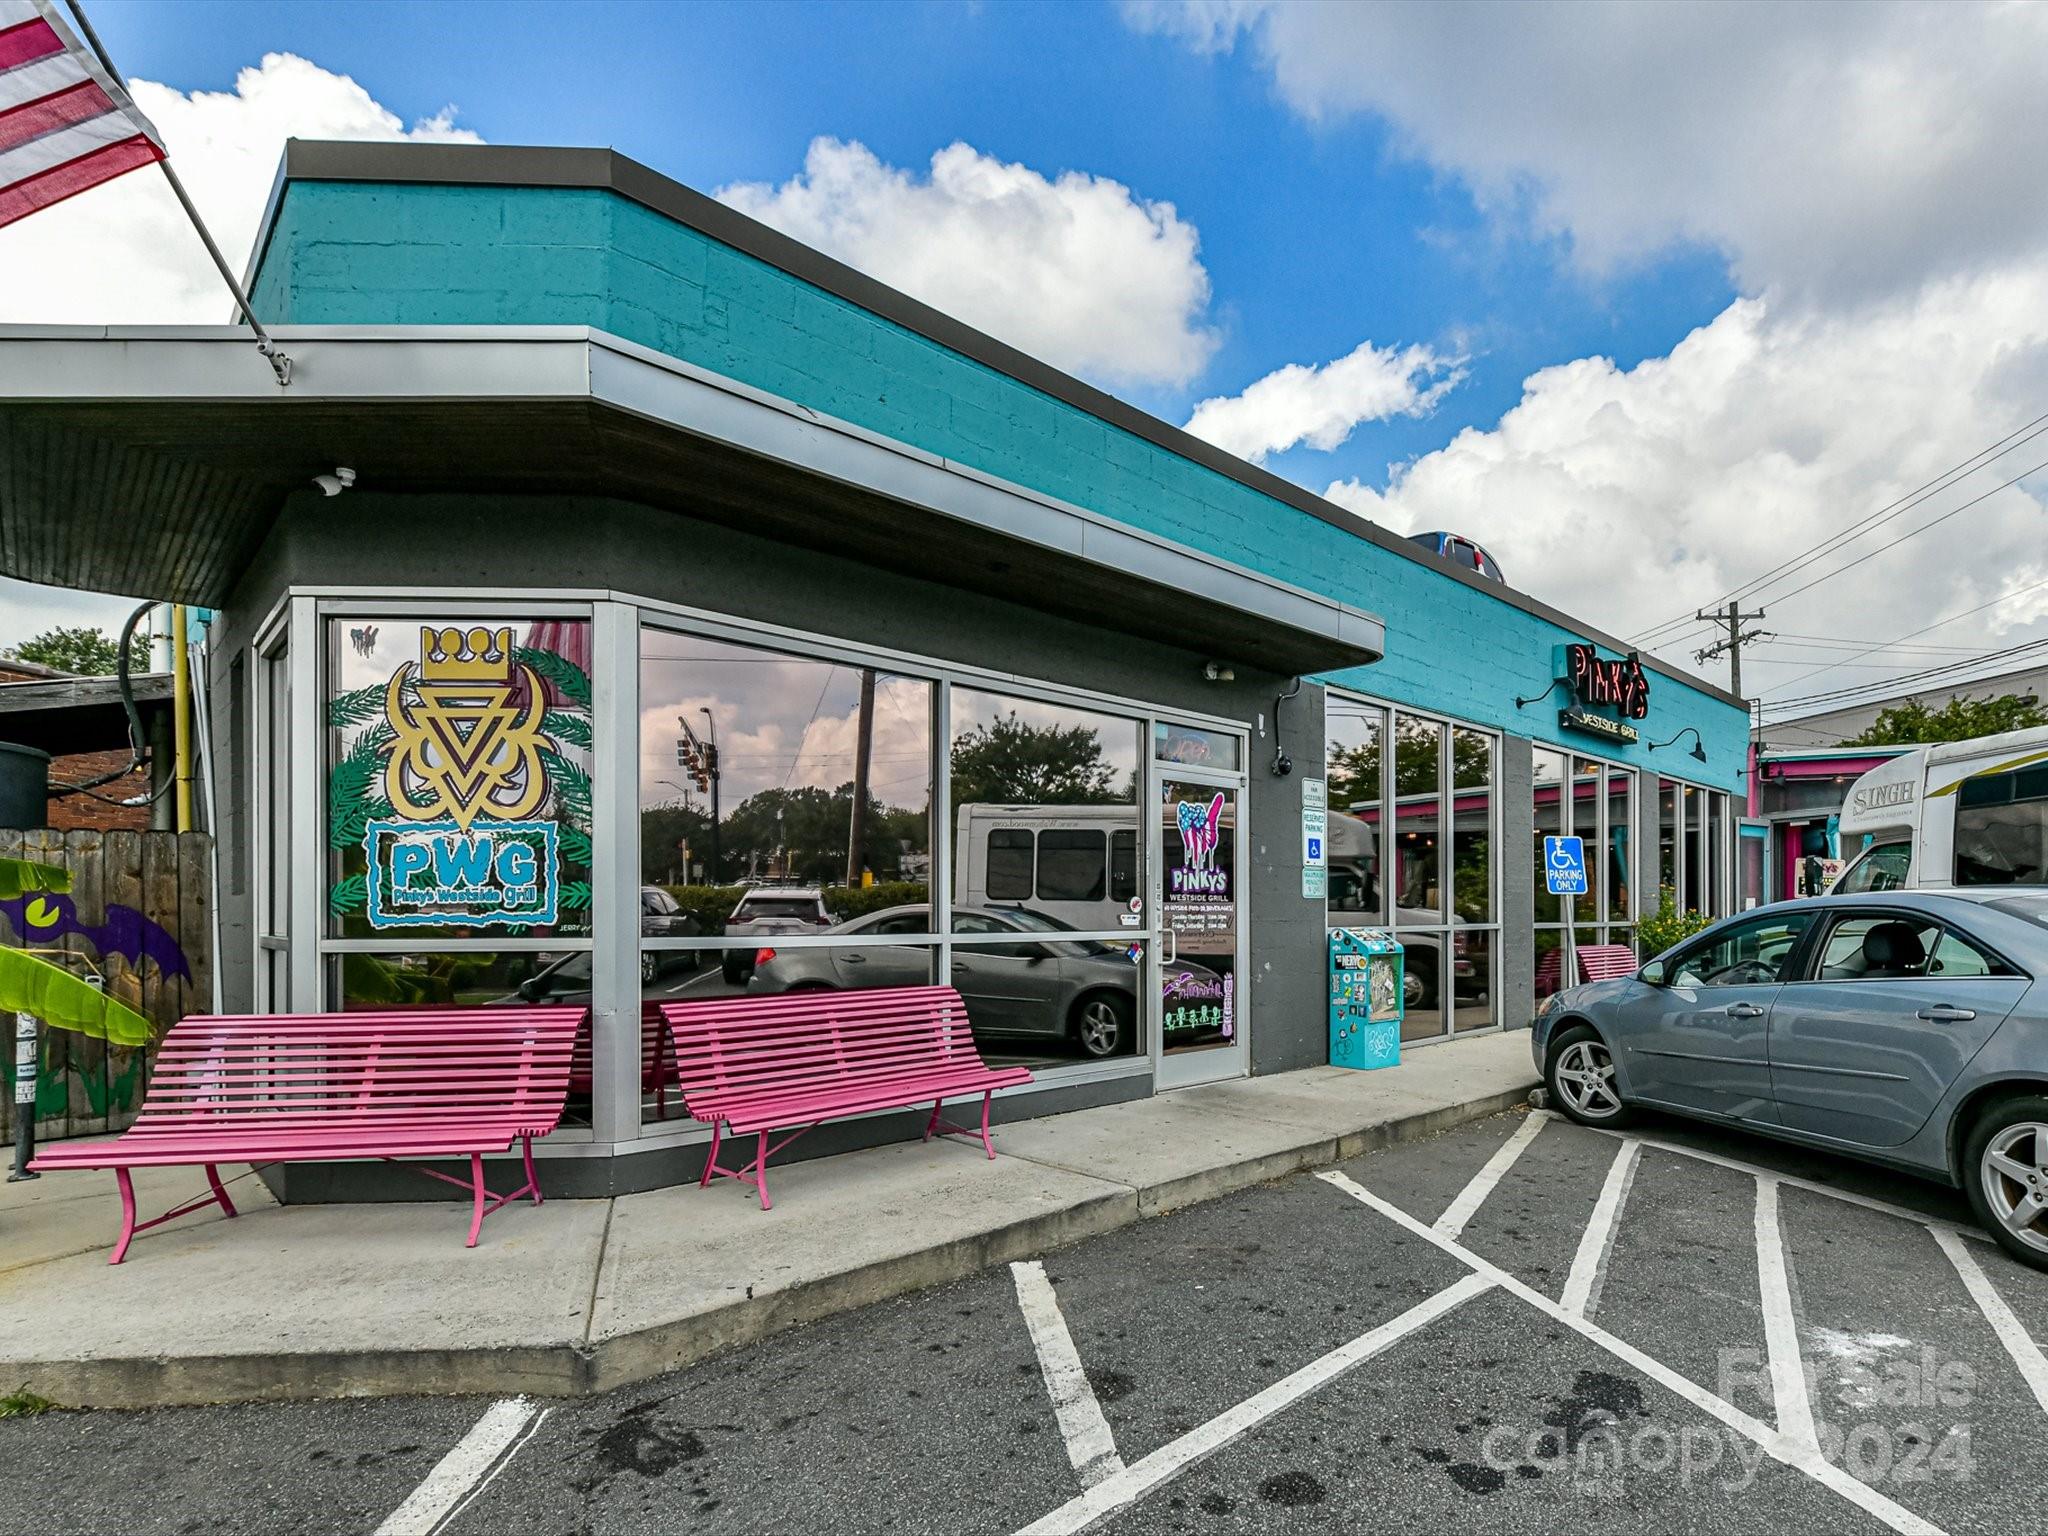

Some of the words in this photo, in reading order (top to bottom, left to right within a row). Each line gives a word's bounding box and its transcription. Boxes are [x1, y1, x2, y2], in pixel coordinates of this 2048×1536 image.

[1853, 781, 1915, 816] SINGH
[1305, 823, 1323, 833] PARKING
[391, 837, 537, 889] PWG
[1550, 869, 1583, 881] PARKING
[1556, 880, 1578, 891] ONLY
[392, 887, 434, 906] Pinky's
[437, 887, 501, 903] Westside
[1169, 893, 1206, 902] WESTSIDE
[1208, 894, 1229, 902] GRILL
